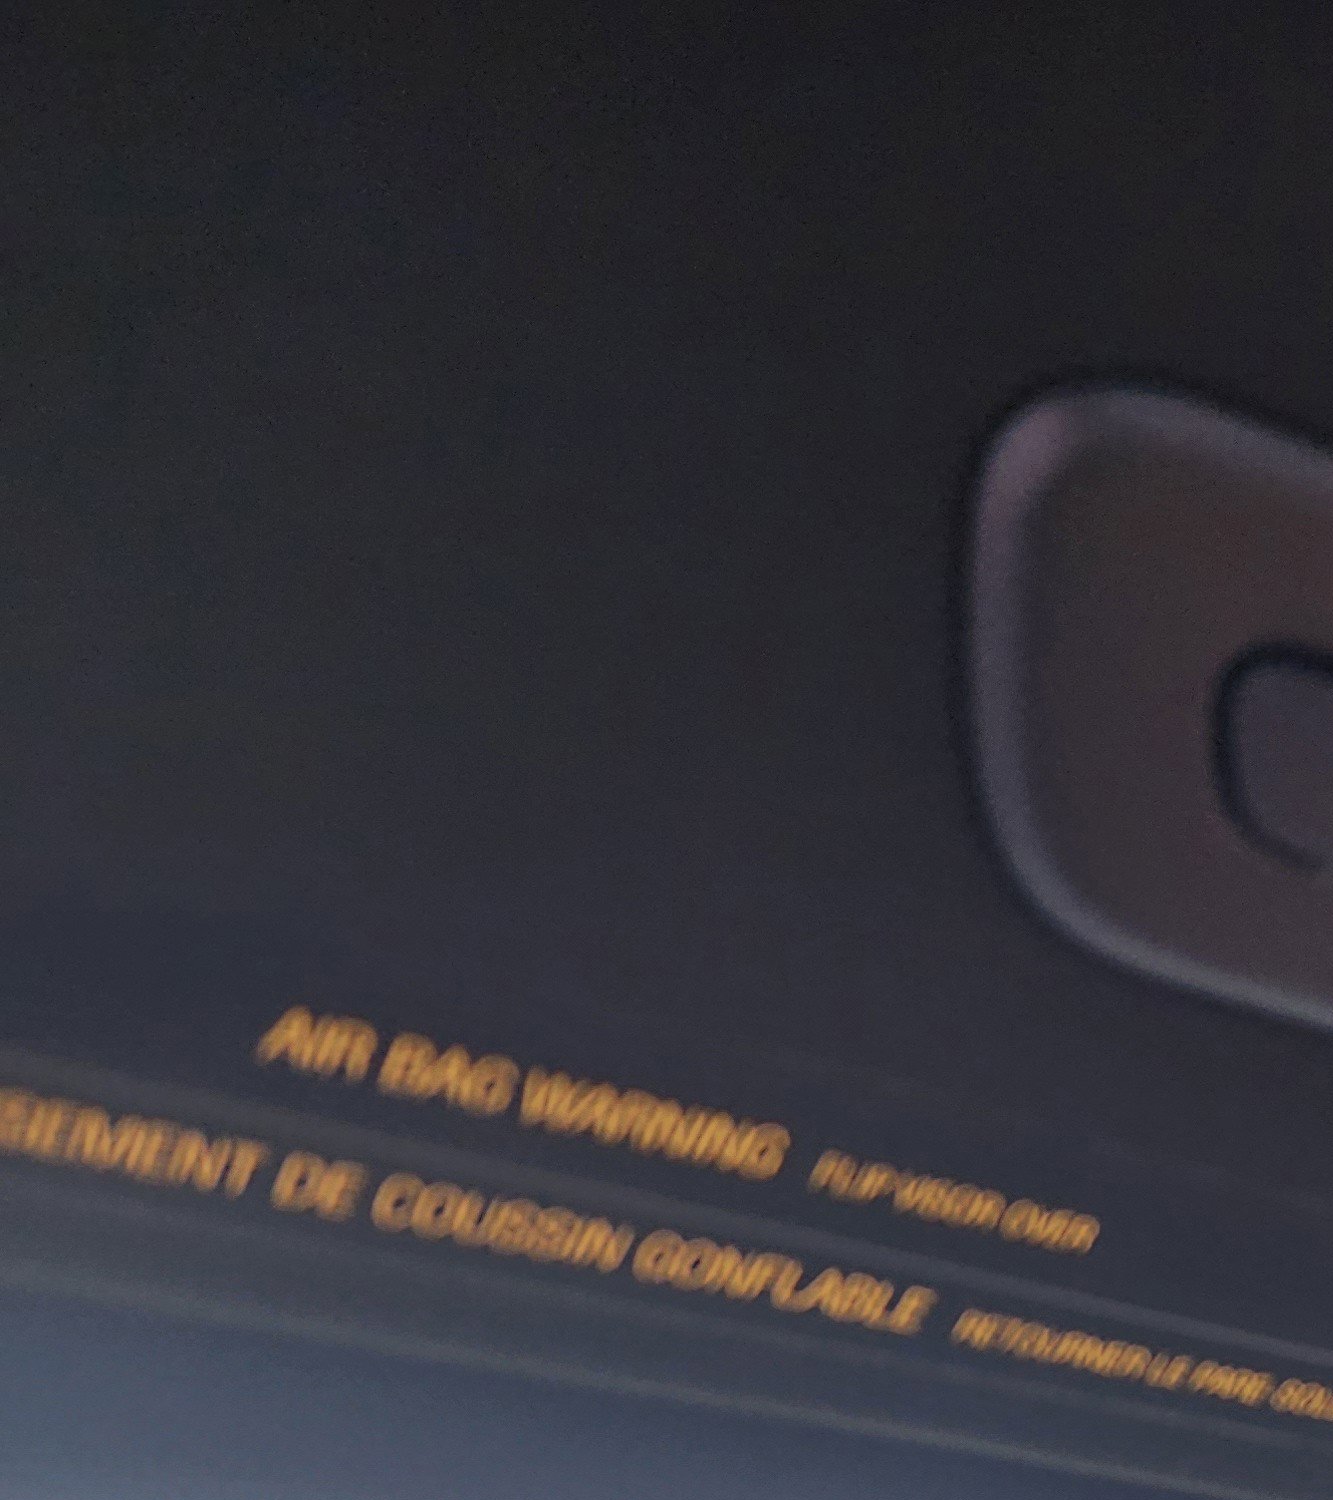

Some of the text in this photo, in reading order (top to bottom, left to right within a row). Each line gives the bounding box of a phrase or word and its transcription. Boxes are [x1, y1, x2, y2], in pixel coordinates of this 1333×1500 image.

[257, 1005, 791, 1182] AIR BAG WARNING
